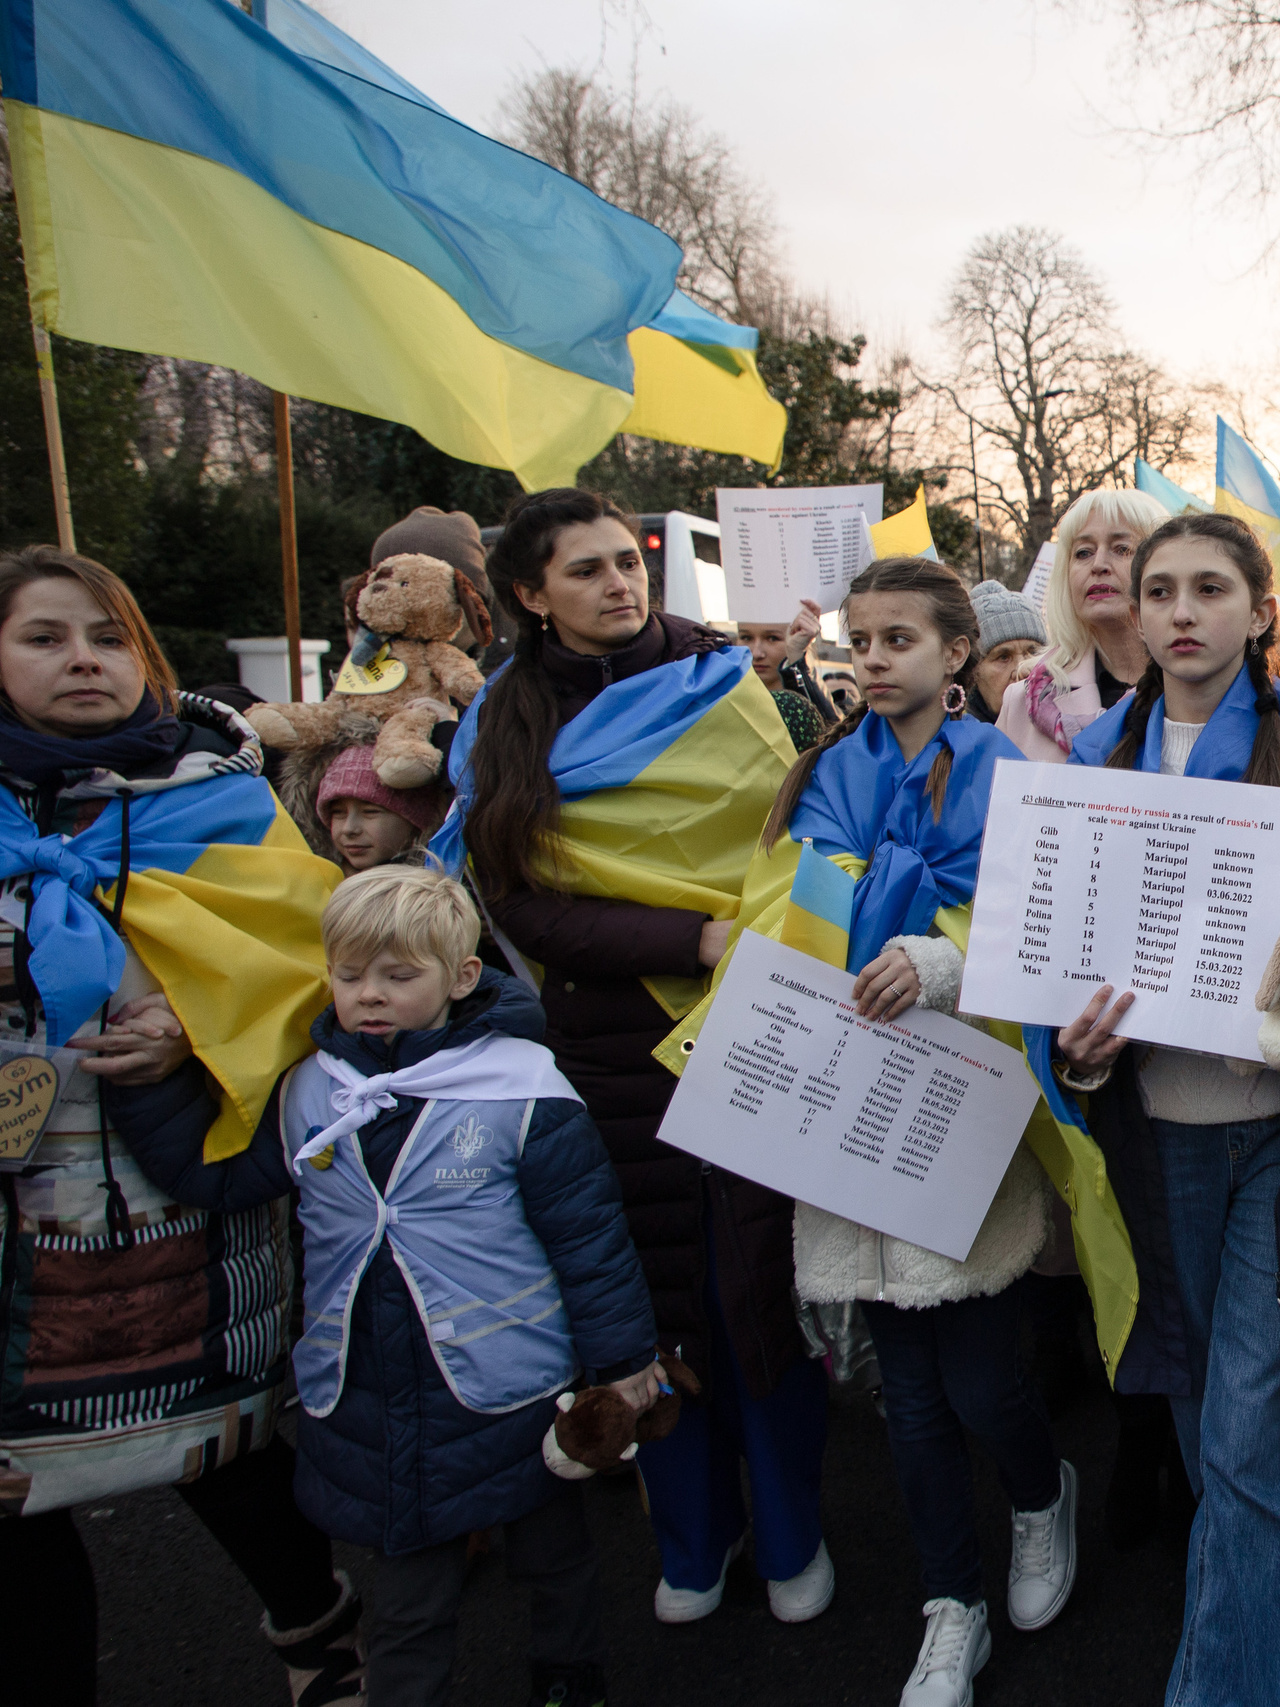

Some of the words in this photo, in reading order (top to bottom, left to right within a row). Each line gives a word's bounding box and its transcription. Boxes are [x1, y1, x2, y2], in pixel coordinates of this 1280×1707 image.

[1021, 795, 1033, 803] 423
[1034, 796, 1064, 807] children
[1067, 801, 1085, 809] were
[1088, 803, 1129, 813] murdered
[1131, 806, 1142, 816] by
[1144, 809, 1169, 819] russia
[1190, 815, 1214, 823] result
[1216, 816, 1225, 824] of
[1260, 821, 1274, 831] full
[1088, 815, 1108, 824] scale
[1110, 817, 1127, 826] war
[1129, 820, 1159, 830] against
[1162, 822, 1197, 834] Ukraine
[1040, 826, 1058, 836] Glib
[1093, 832, 1103, 841] 12
[1146, 838, 1189, 852] Mariupol
[1214, 848, 1255, 860] unknown
[1034, 853, 1058, 866] Katya
[1090, 860, 1100, 869] 14
[1143, 866, 1186, 880] Mariupol
[1211, 876, 1251, 889] unknown
[1036, 868, 1052, 878] Not
[1090, 874, 1096, 883] 8
[1142, 880, 1184, 895] Mariupol
[1207, 889, 1252, 903] 03.06.2022
[1032, 881, 1052, 892] Sofia
[1087, 888, 1097, 897] 13
[1140, 894, 1183, 909] Mariupol
[1208, 905, 1248, 918] unknown
[1024, 922, 1051, 936] Serhiy
[1083, 930, 1094, 939] 18
[1136, 936, 1176, 951] Mariupol
[1200, 948, 1242, 961] unknown
[1018, 950, 1050, 963] Karyna
[1081, 958, 1091, 967] 13
[1133, 964, 1171, 979] Mariupol
[1193, 974, 1240, 990] 15.03.2022
[1022, 964, 1042, 975] Max
[1062, 970, 1068, 978] 3
[1071, 973, 1106, 982] months
[1130, 978, 1168, 993] Mariupol
[1190, 988, 1238, 1004] 23.03.2022
[835, 1012, 854, 1024] scale
[856, 1020, 871, 1031] war
[872, 1028, 900, 1043] against
[900, 1038, 931, 1057] Ukraine
[11, 1066, 27, 1078] 63
[764, 1033, 782, 1044] Ania
[829, 1059, 838, 1067] 12
[876, 1078, 902, 1093] Lyman
[921, 1096, 957, 1116] 18.05.2022
[799, 1023, 813, 1035] boy
[838, 1040, 846, 1048] 12
[881, 1058, 915, 1076] Mariupol
[929, 1077, 965, 1097] 26.05.2022
[0, 1071, 52, 1109] sym
[754, 1039, 784, 1057] Karolina
[868, 1086, 902, 1104] Mariupol
[918, 1108, 950, 1124] unknown
[0, 1103, 42, 1135] riupol
[729, 1098, 758, 1115] Kristina
[799, 1127, 808, 1135] 13
[840, 1142, 880, 1164] Volnovakha
[893, 1165, 925, 1182] unknown
[435, 1168, 491, 1179] ПЛАСТ
